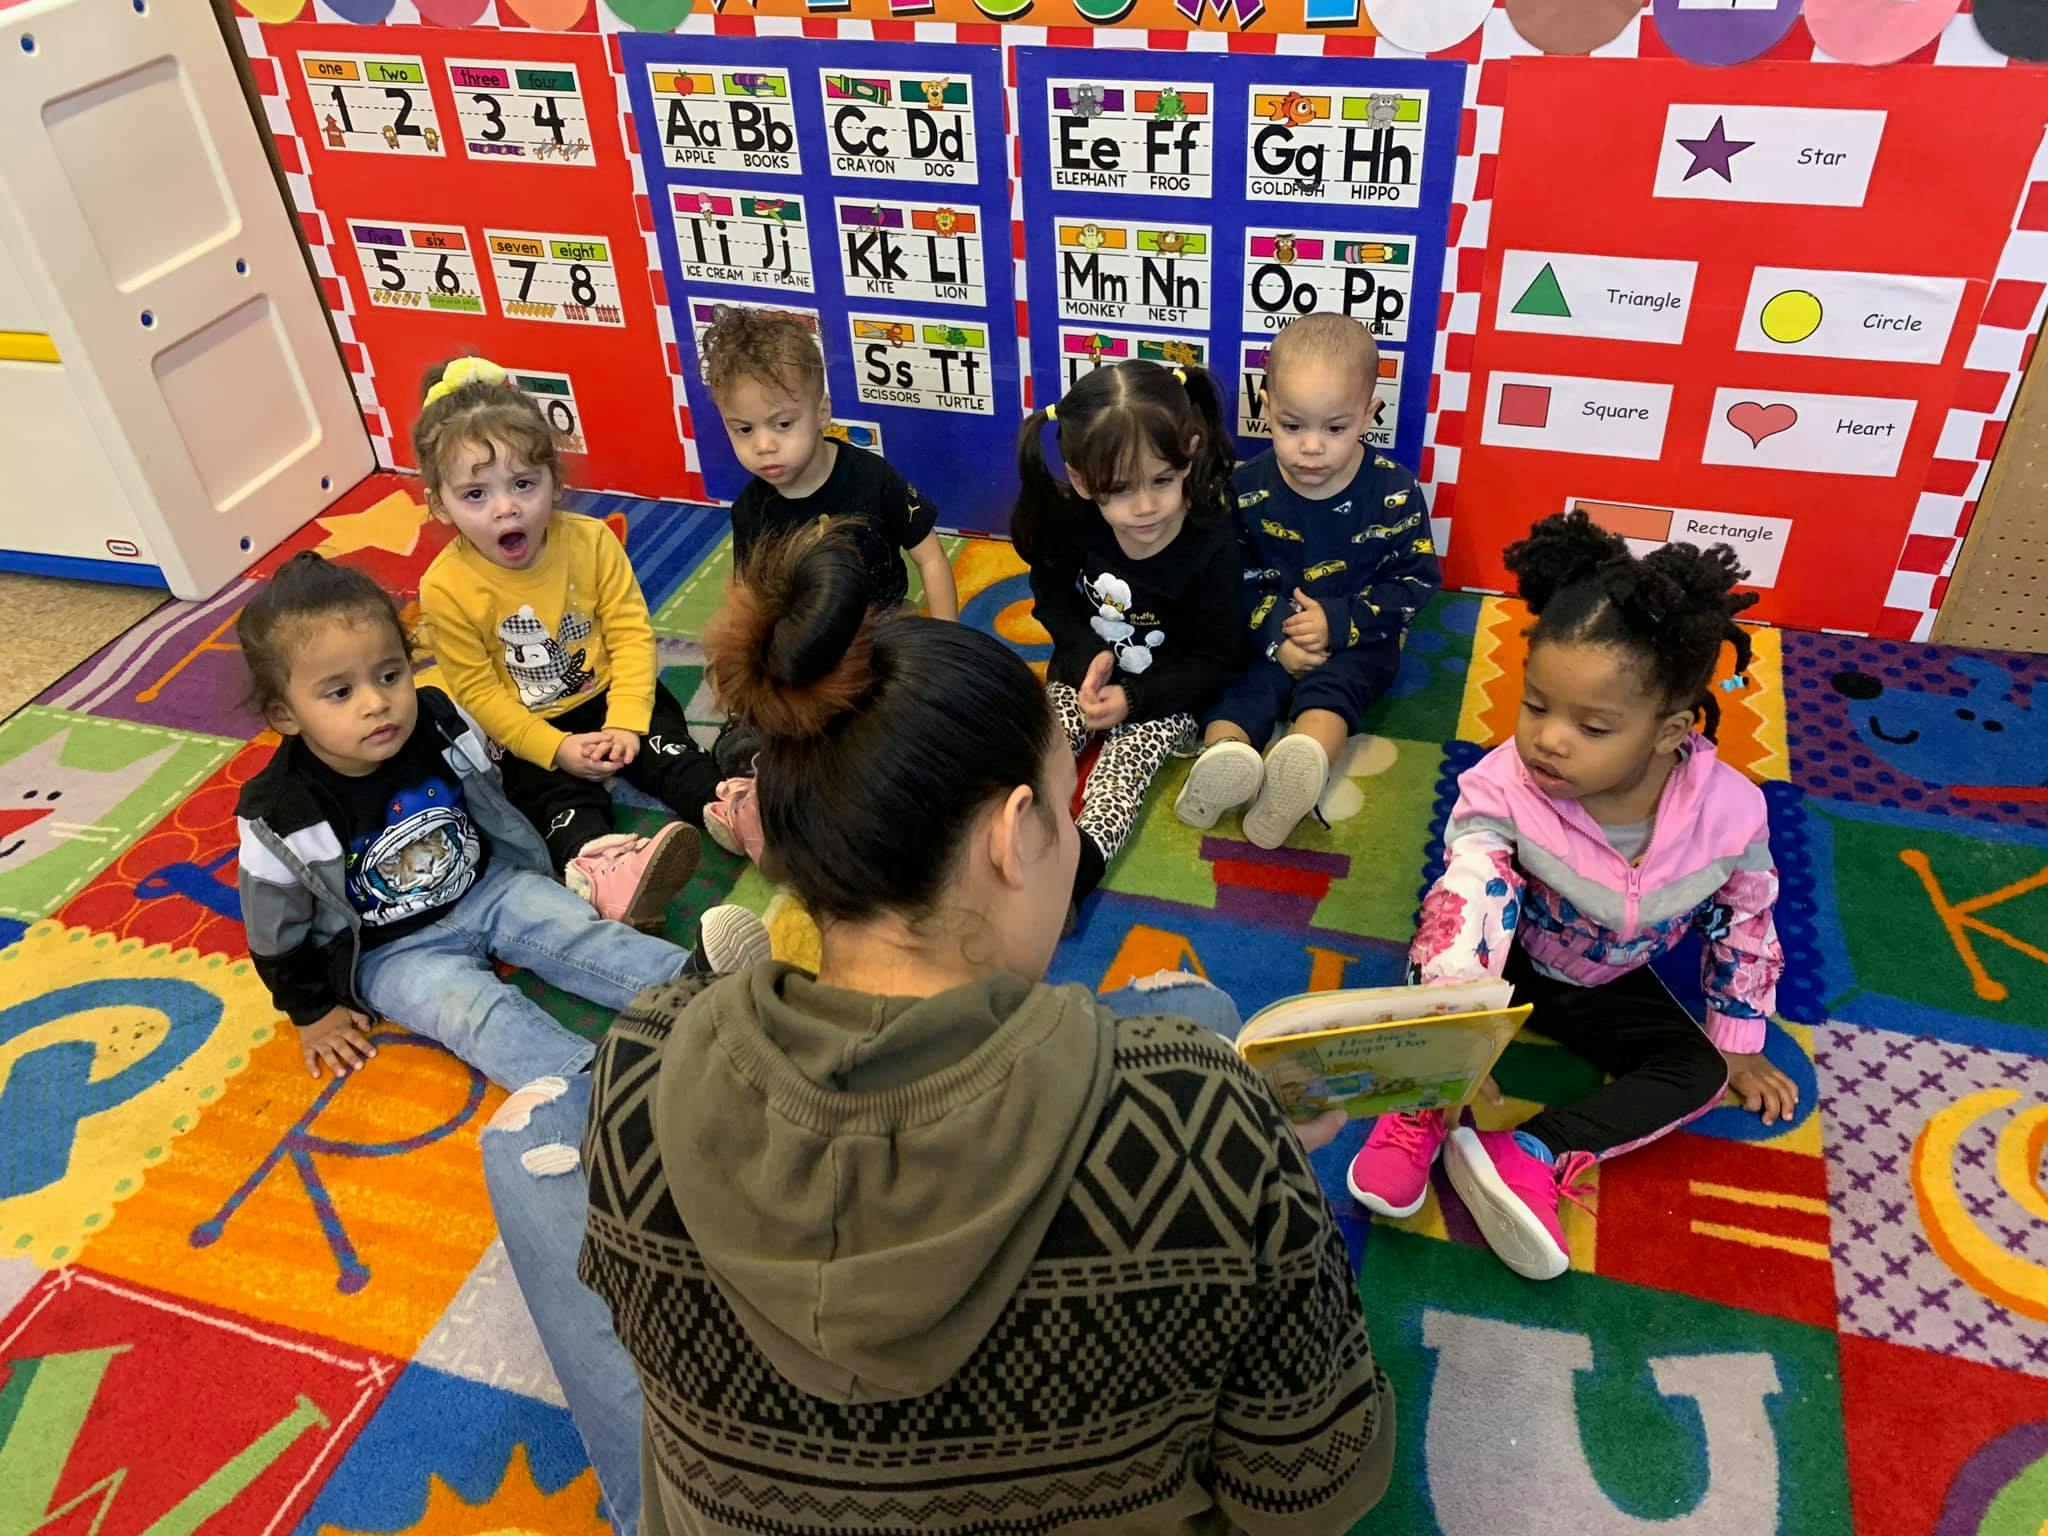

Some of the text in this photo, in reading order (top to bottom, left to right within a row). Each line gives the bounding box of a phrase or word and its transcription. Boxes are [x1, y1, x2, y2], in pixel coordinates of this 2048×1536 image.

[318, 63, 408, 81] one two
[460, 70, 557, 88] three four
[331, 85, 421, 136] 1 2
[472, 93, 565, 144] 3 4
[666, 99, 794, 152] Aa Bb
[834, 105, 964, 162] Cc Dd
[1060, 116, 1200, 175] Ee Ff
[675, 150, 789, 169] APPLE BOOKS
[837, 157, 955, 177] CRAYON DOG
[1254, 124, 1412, 193] Gg Hh
[1797, 148, 1846, 167] Star
[1056, 171, 1190, 191] ELEPHANT FROG
[1351, 184, 1400, 201] HIPPO
[426, 233, 446, 247] six
[497, 242, 595, 261] seven eight
[762, 224, 791, 279] Jj
[847, 231, 908, 280] Kk
[373, 249, 460, 296] 5 6
[508, 260, 596, 307] 7 8
[686, 265, 810, 287] ICE CREAM JET PLANE
[1064, 252, 1199, 308] Mm Nn
[866, 279, 968, 300] KITE LION
[1251, 264, 1403, 333] Oo Pp
[1606, 288, 1682, 310] Triangle
[1066, 301, 1187, 323] MONKEY NEST
[1863, 313, 1922, 333] Circle
[865, 344, 980, 395] Ss Tt
[862, 388, 985, 410] SCISSORS TURTLE
[1581, 401, 1650, 421] Square
[1835, 418, 1896, 437] Heart
[1686, 519, 1774, 543] Rectangle
